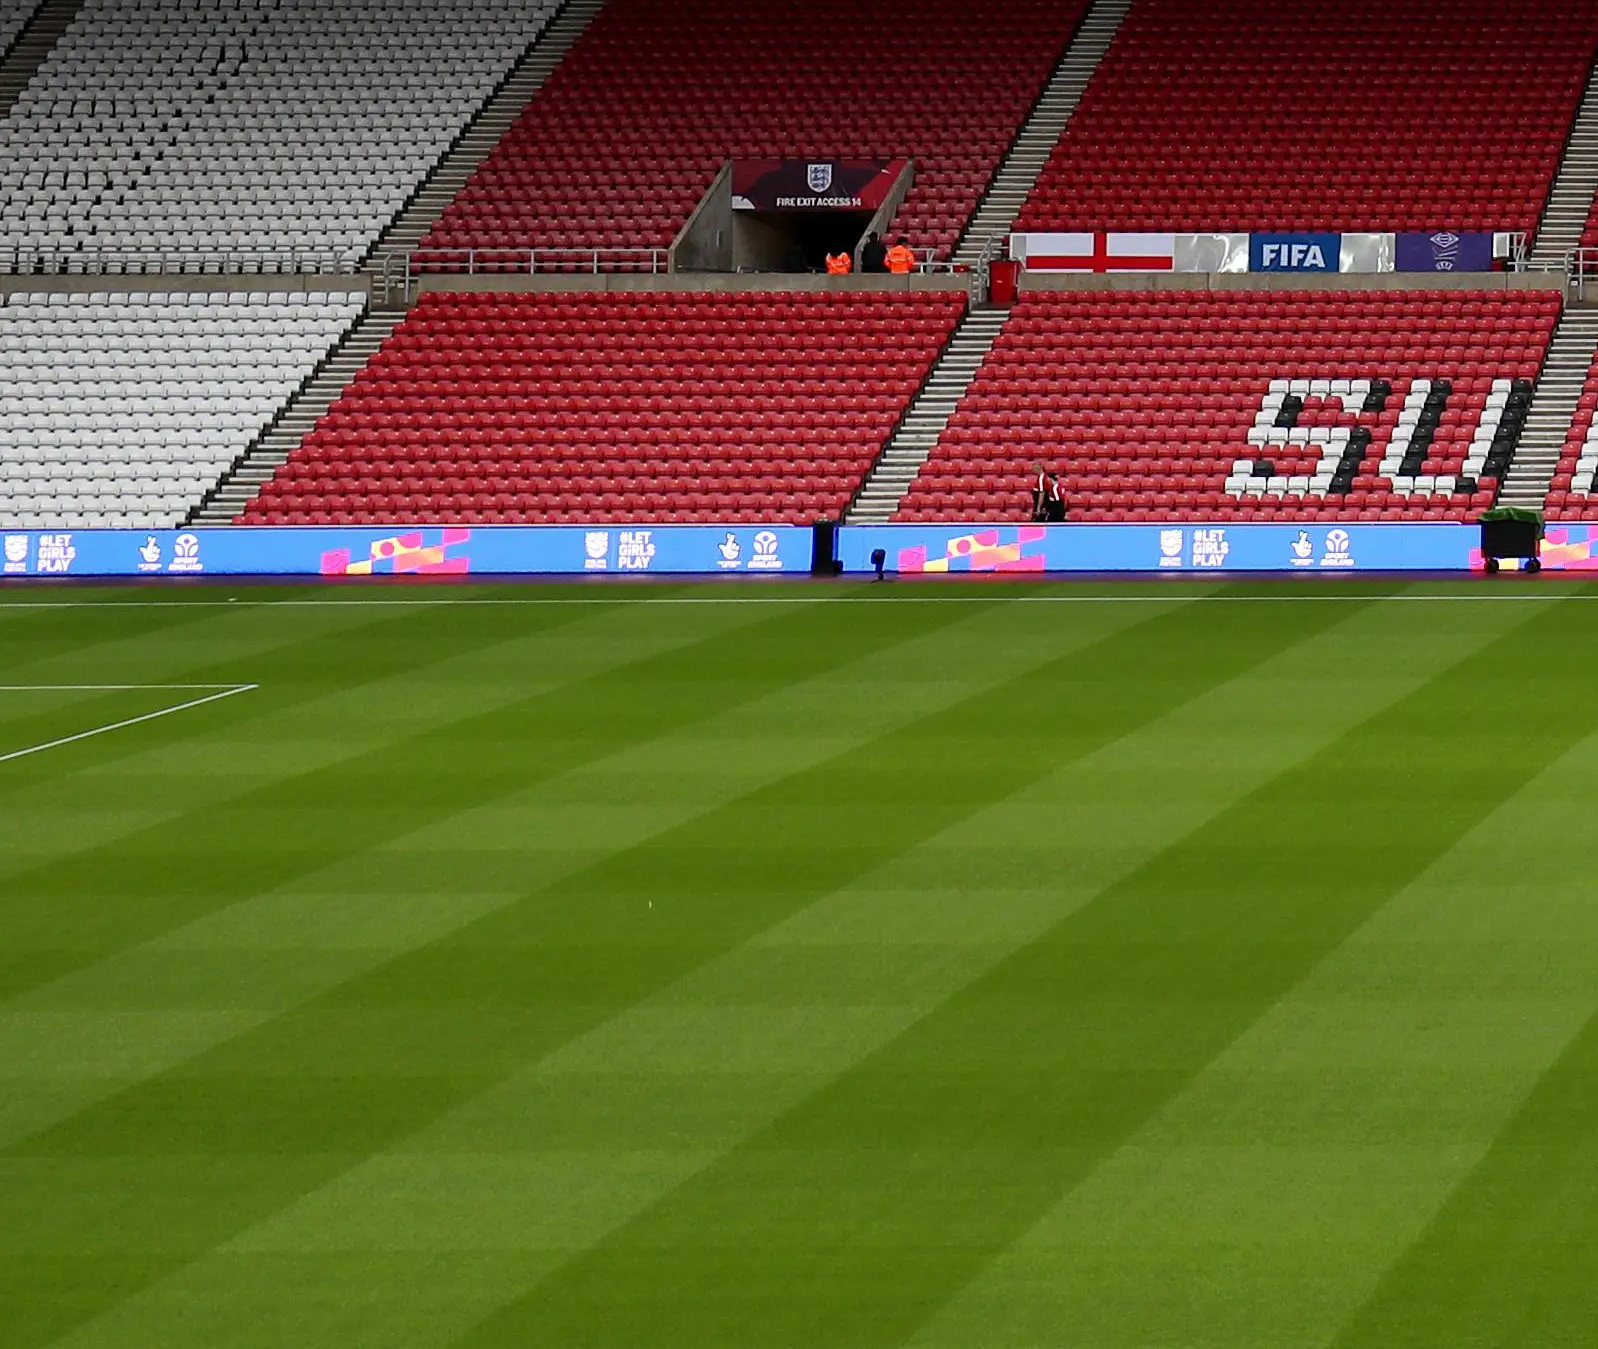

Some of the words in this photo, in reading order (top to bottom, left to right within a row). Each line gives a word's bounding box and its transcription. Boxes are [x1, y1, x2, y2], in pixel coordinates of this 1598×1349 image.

[776, 196, 796, 207] FIRE
[796, 196, 816, 207] EXIT
[816, 196, 851, 207] ACCESS
[1262, 243, 1326, 268] FIFA
[38, 559, 71, 571] PLAY
[619, 556, 650, 568] PLAY
[1193, 554, 1225, 566] PLAY
